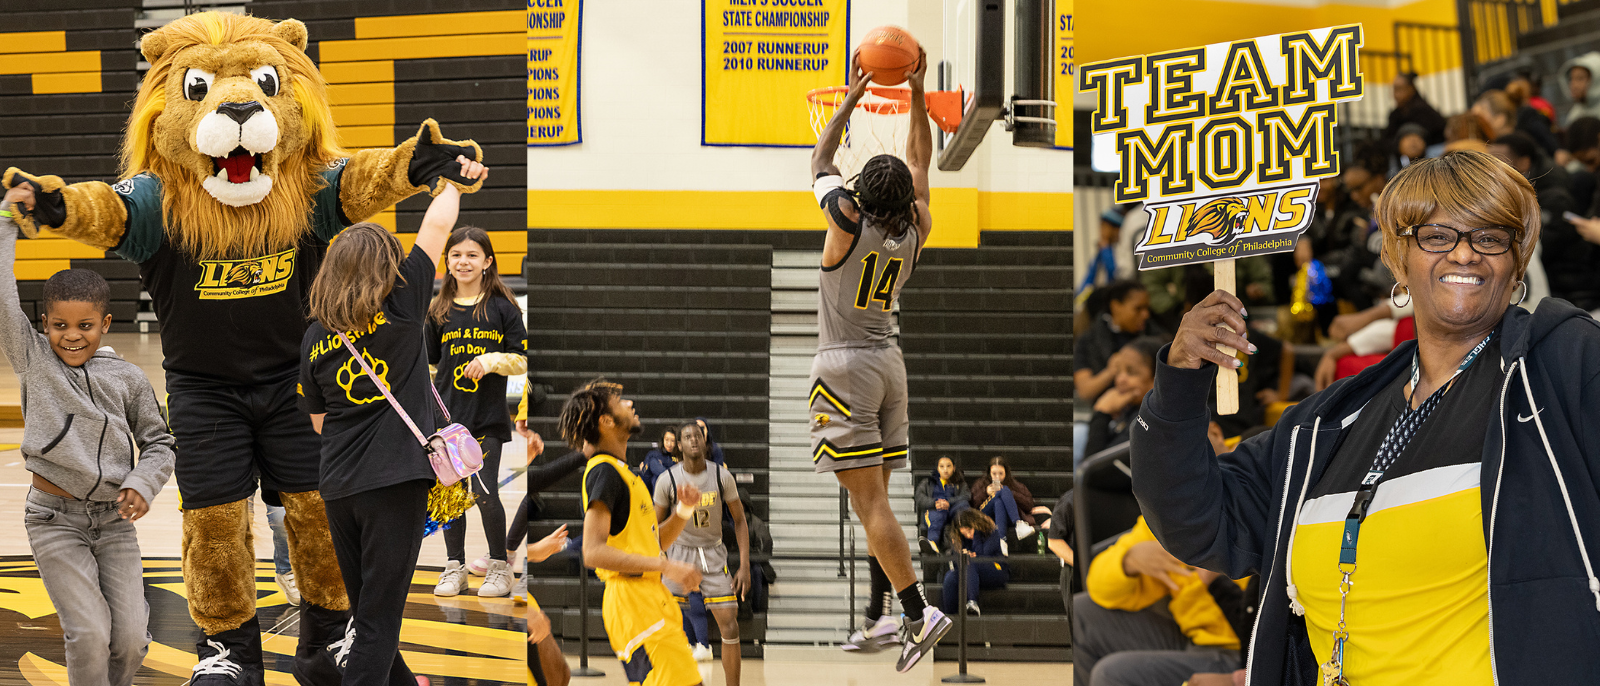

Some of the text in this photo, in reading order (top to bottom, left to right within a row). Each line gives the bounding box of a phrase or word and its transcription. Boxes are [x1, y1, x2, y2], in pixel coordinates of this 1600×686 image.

[723, 10, 830, 27] STATE CHAMPIONSHIP
[527, 48, 552, 61] RUP
[723, 41, 829, 54] 2007 RUNNERUP
[723, 57, 829, 71] 2010 RUNNERUP
[1079, 23, 1364, 133] TEAM
[1115, 102, 1340, 204] MOM
[1147, 238, 1293, 263] Community College of Philadelphia
[854, 250, 904, 312] 14
[203, 283, 285, 297] Community College of Philadelphia
[463, 328, 472, 338] &
[473, 327, 504, 344] Family
[450, 343, 487, 356] Fun Day
[692, 508, 711, 529] 12
